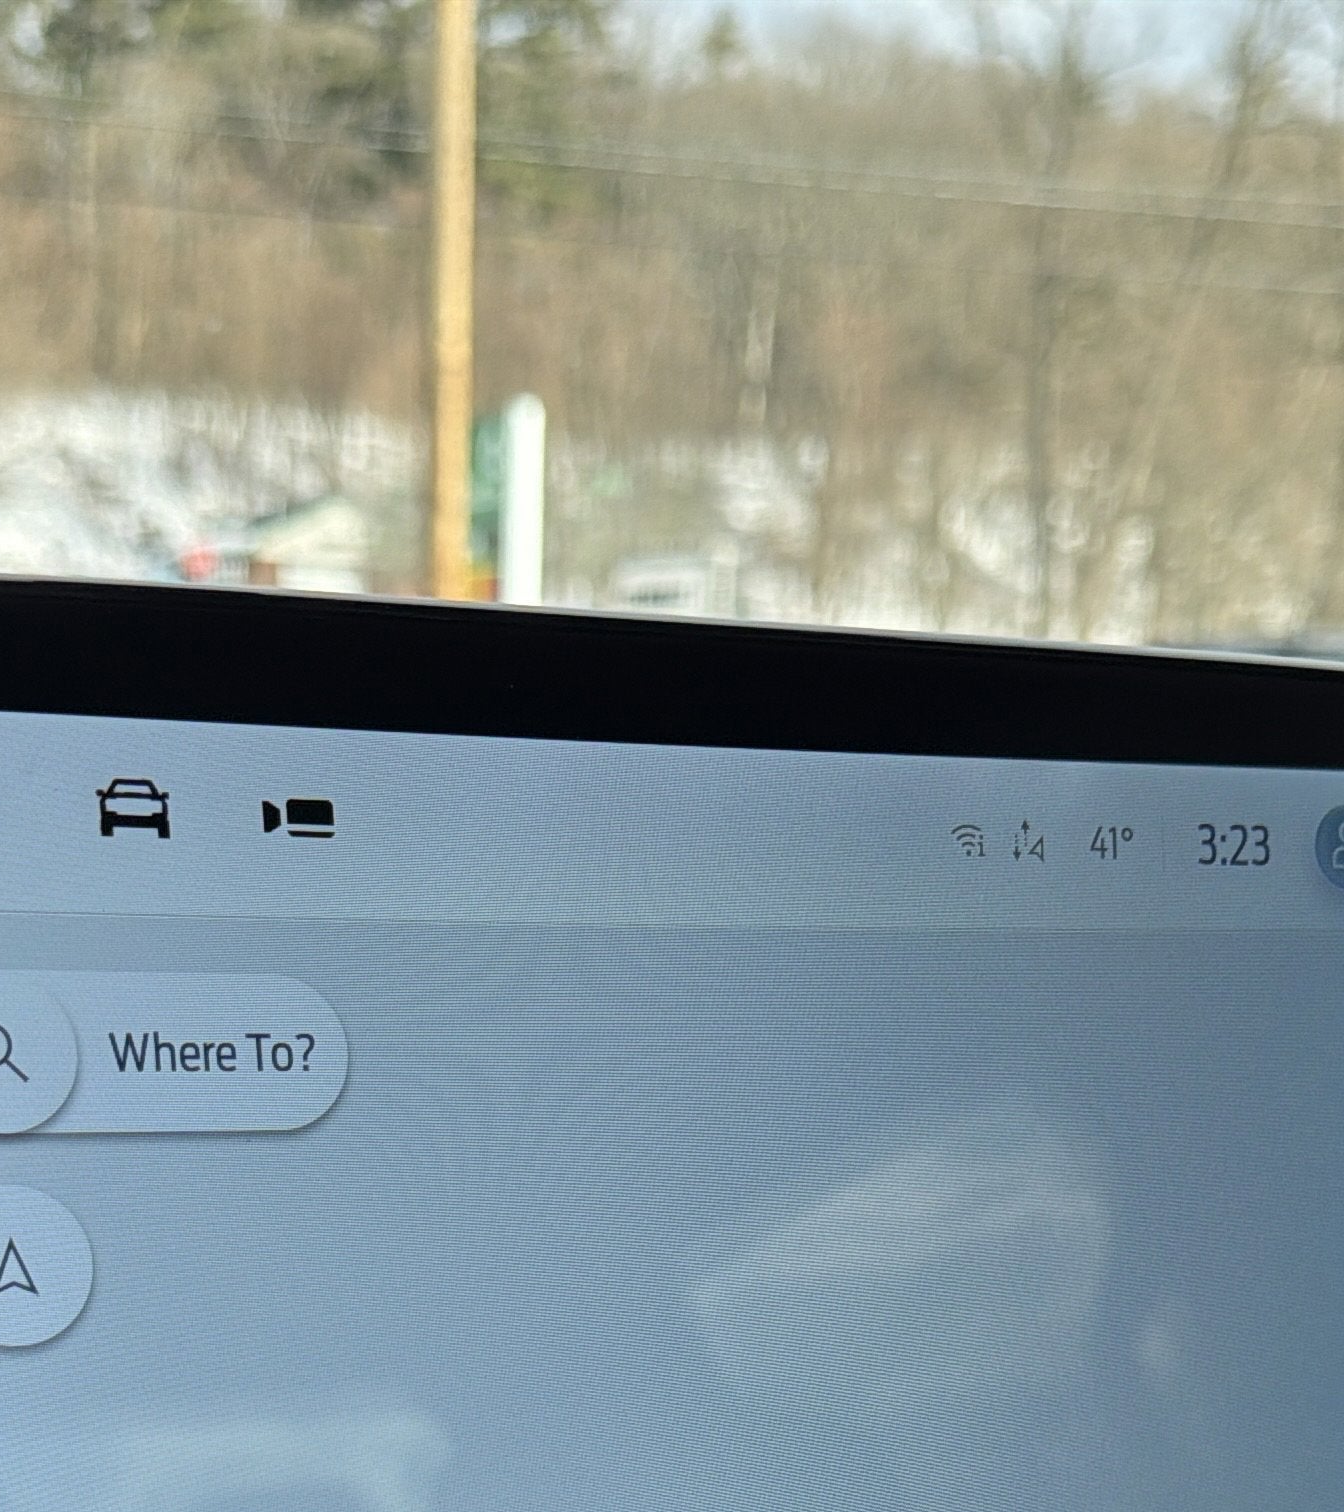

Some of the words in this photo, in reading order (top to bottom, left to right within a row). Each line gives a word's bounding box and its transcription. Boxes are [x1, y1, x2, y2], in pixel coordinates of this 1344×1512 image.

[1197, 823, 1272, 866] 3:23
[108, 1031, 236, 1073] Where
[246, 1032, 316, 1073] To?
